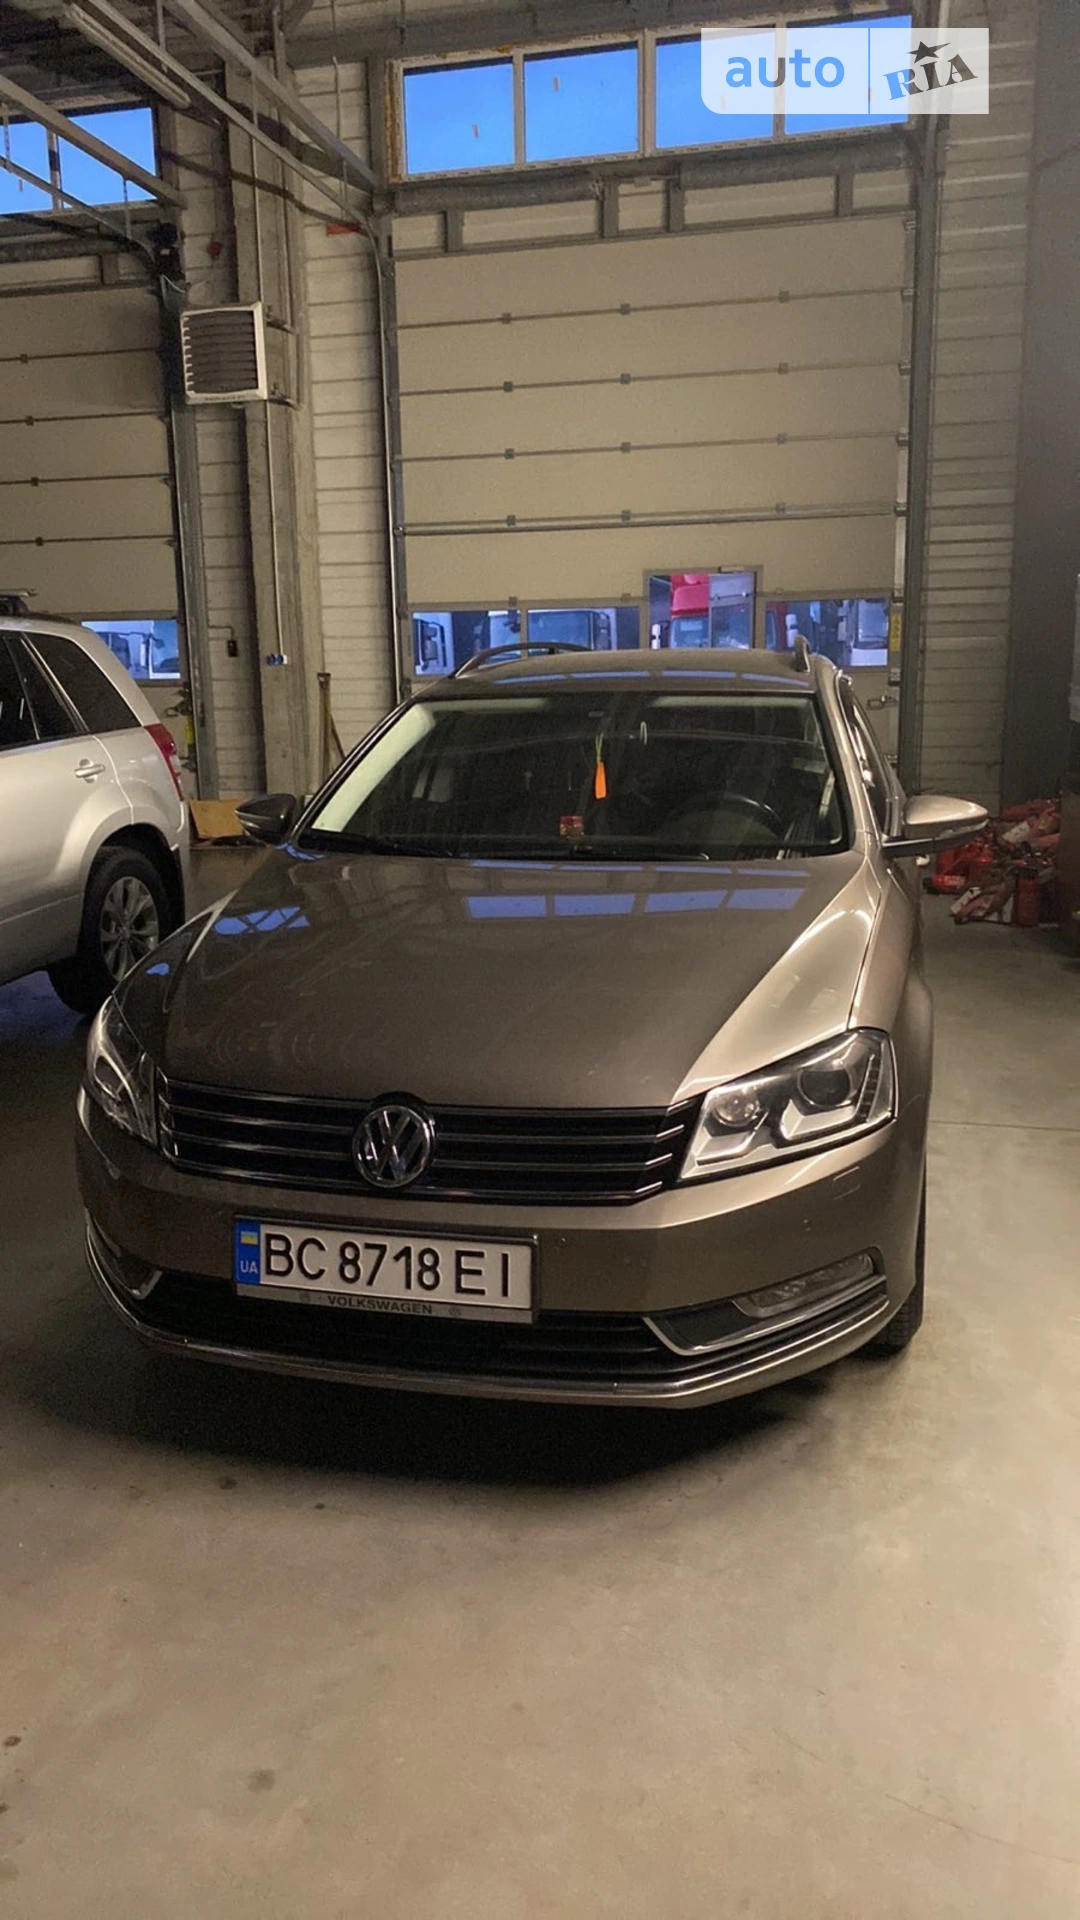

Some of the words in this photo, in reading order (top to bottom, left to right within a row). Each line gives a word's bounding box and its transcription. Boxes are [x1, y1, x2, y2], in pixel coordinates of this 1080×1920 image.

[240, 1260, 258, 1275] UA
[264, 1232, 328, 1281] BC
[338, 1241, 441, 1292] 8718
[454, 1249, 510, 1298] EI
[327, 1295, 433, 1315] VOLKSWAGEN
